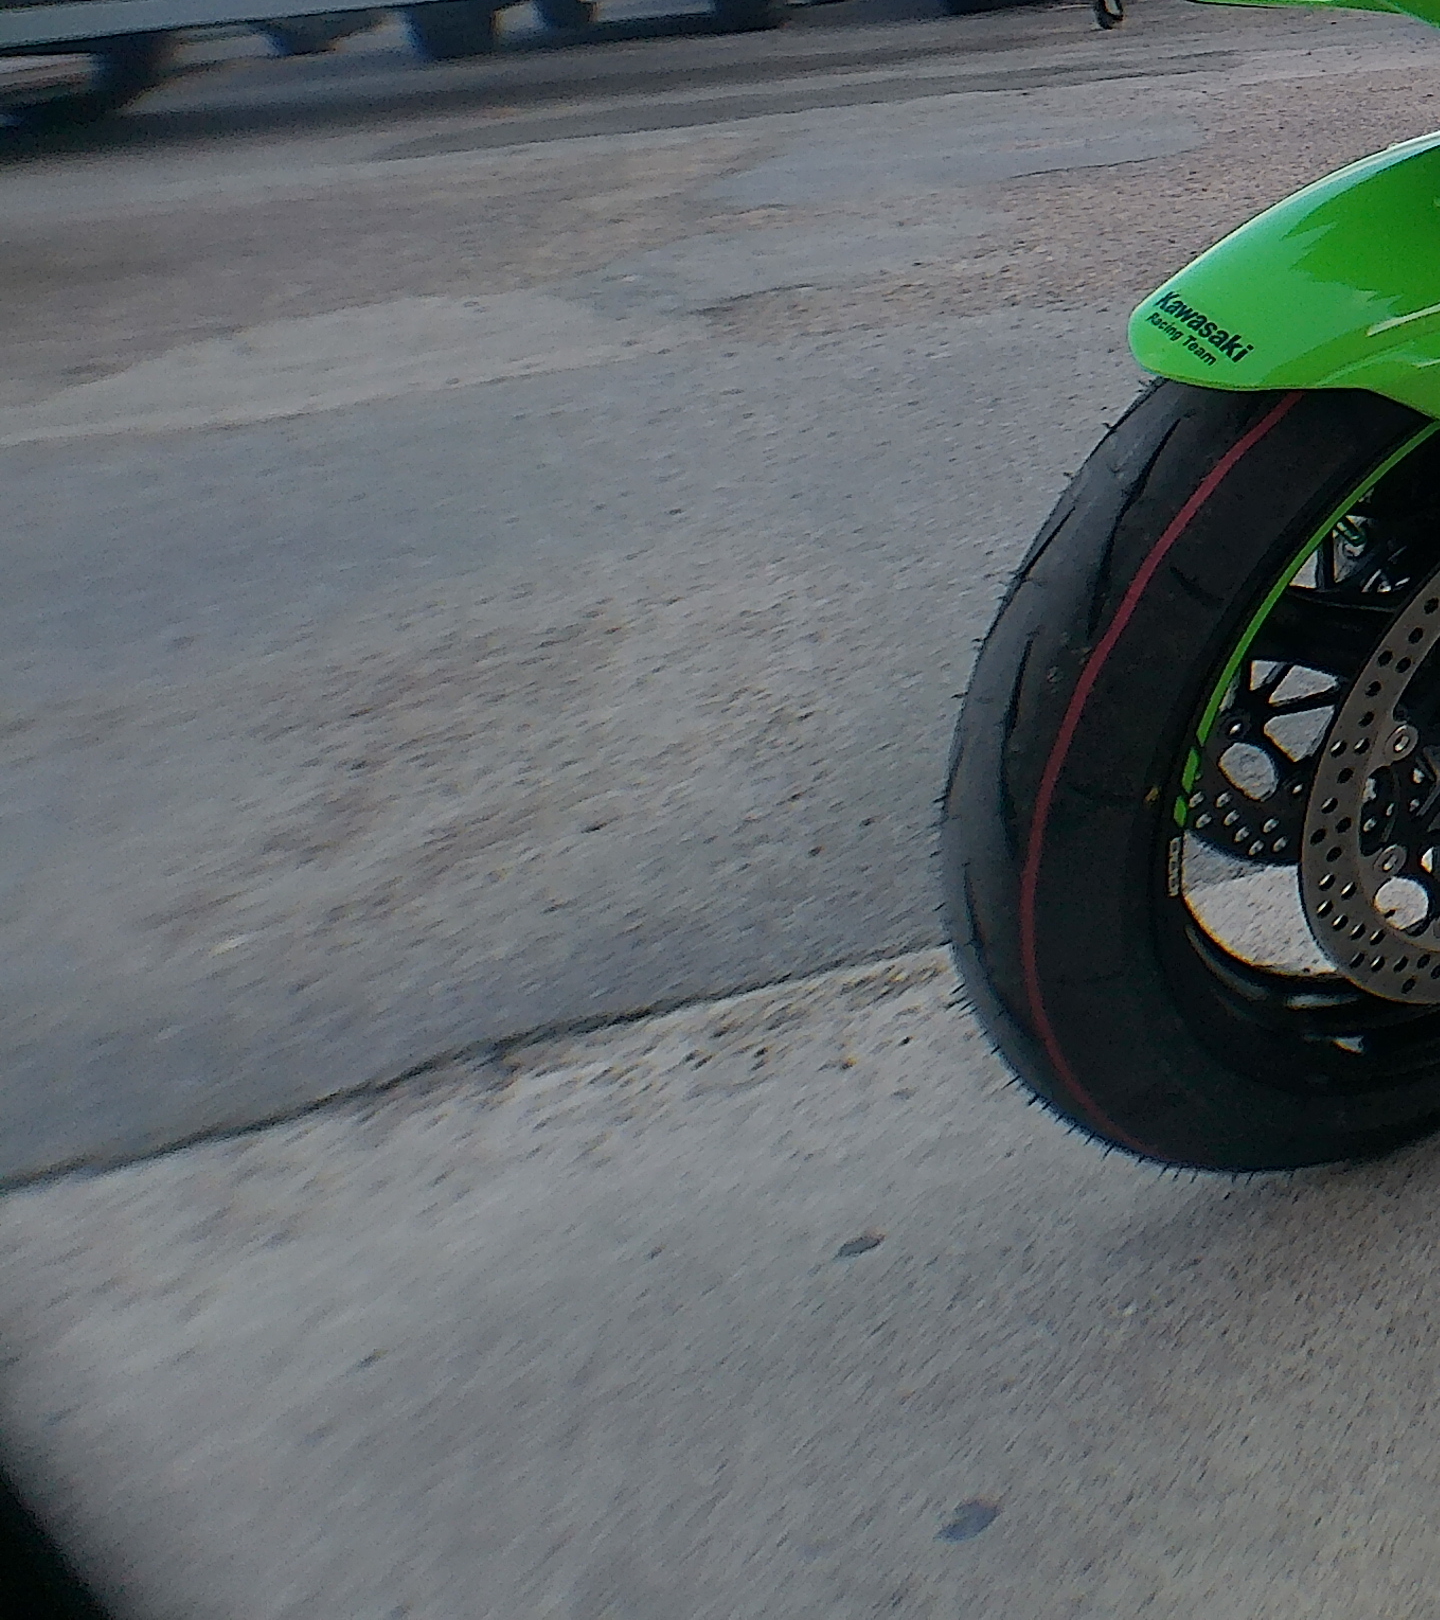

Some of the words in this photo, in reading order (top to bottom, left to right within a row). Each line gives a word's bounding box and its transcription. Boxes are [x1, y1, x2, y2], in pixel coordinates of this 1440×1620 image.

[1146, 311, 1184, 342] Racing
[1182, 334, 1217, 367] Team
[1153, 290, 1255, 364] Kawasaki
